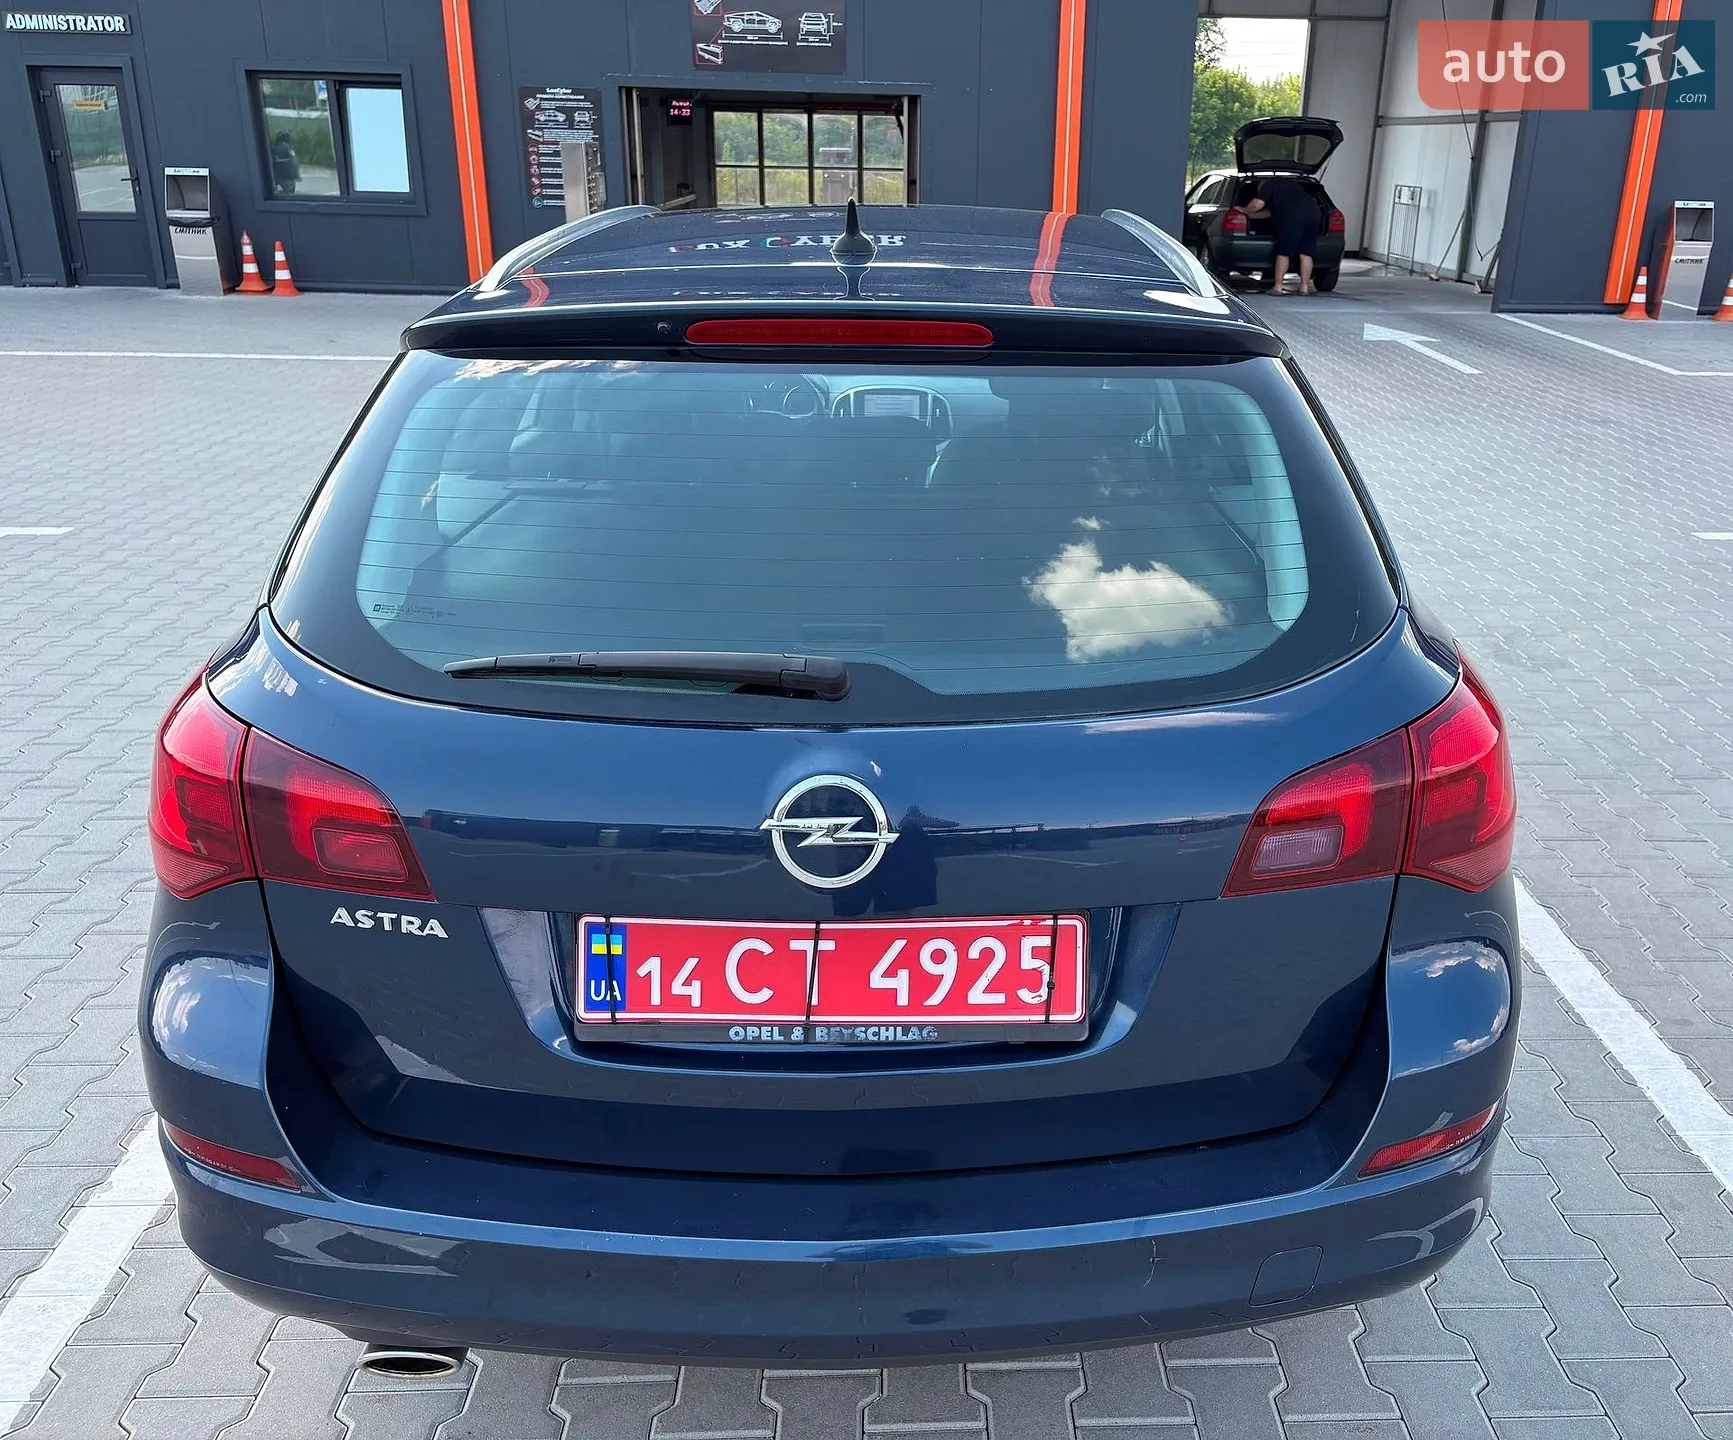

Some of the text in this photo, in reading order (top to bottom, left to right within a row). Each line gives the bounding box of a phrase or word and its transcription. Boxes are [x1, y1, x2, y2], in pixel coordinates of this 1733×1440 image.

[6, 13, 126, 32] ADMINISTRATOR
[330, 906, 449, 938] ASTRA
[635, 935, 1052, 1008] 14 CT 4925
[590, 979, 622, 1001] UA
[728, 1026, 939, 1041] OPEL & BEYSCHLAG
